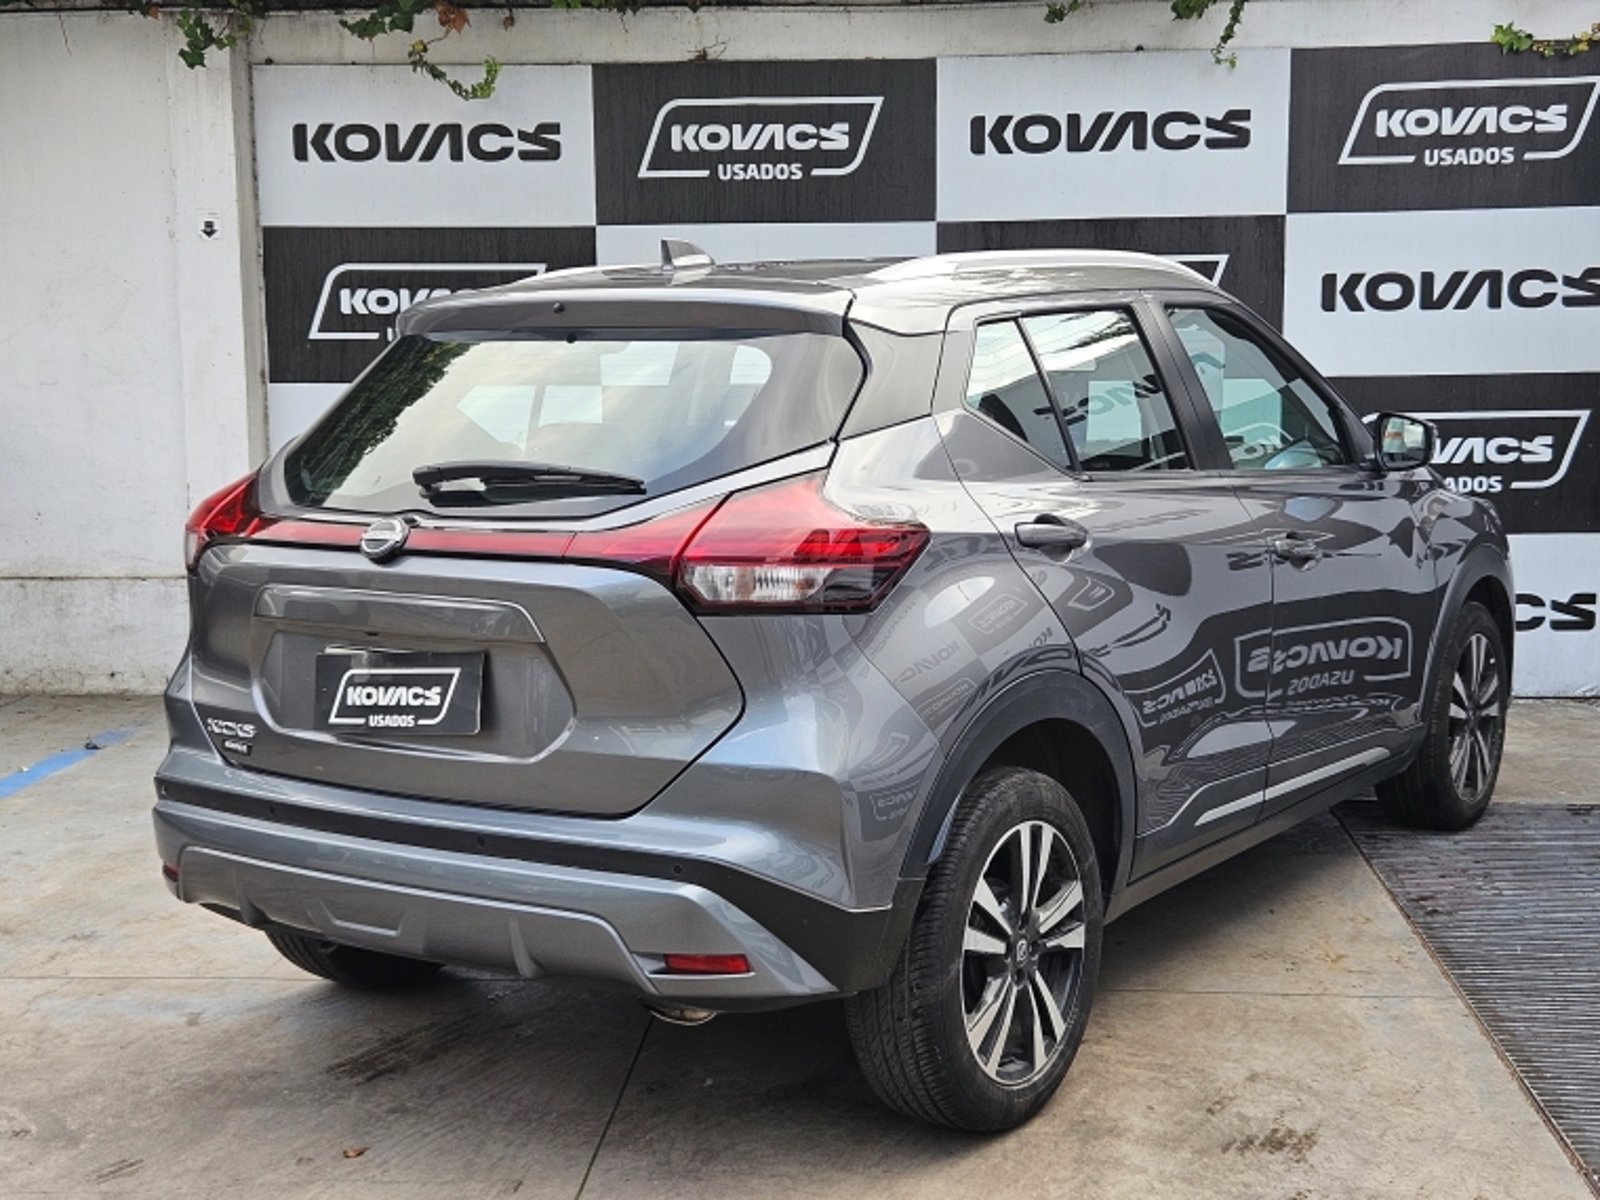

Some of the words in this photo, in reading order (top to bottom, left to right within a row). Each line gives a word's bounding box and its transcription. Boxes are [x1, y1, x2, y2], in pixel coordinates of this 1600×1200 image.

[970, 108, 1252, 156] KOVACS
[1375, 104, 1568, 138] KOVACS
[292, 122, 562, 163] KOVACS
[670, 122, 850, 152] KOVACS
[1424, 146, 1515, 167] USADOS
[717, 163, 803, 181] USADOS
[1320, 267, 1600, 313] KOVACS
[1430, 434, 1553, 464] VACS
[1445, 475, 1503, 493] ADOS
[346, 686, 442, 706] KOVACS
[368, 714, 415, 727] USADOS
